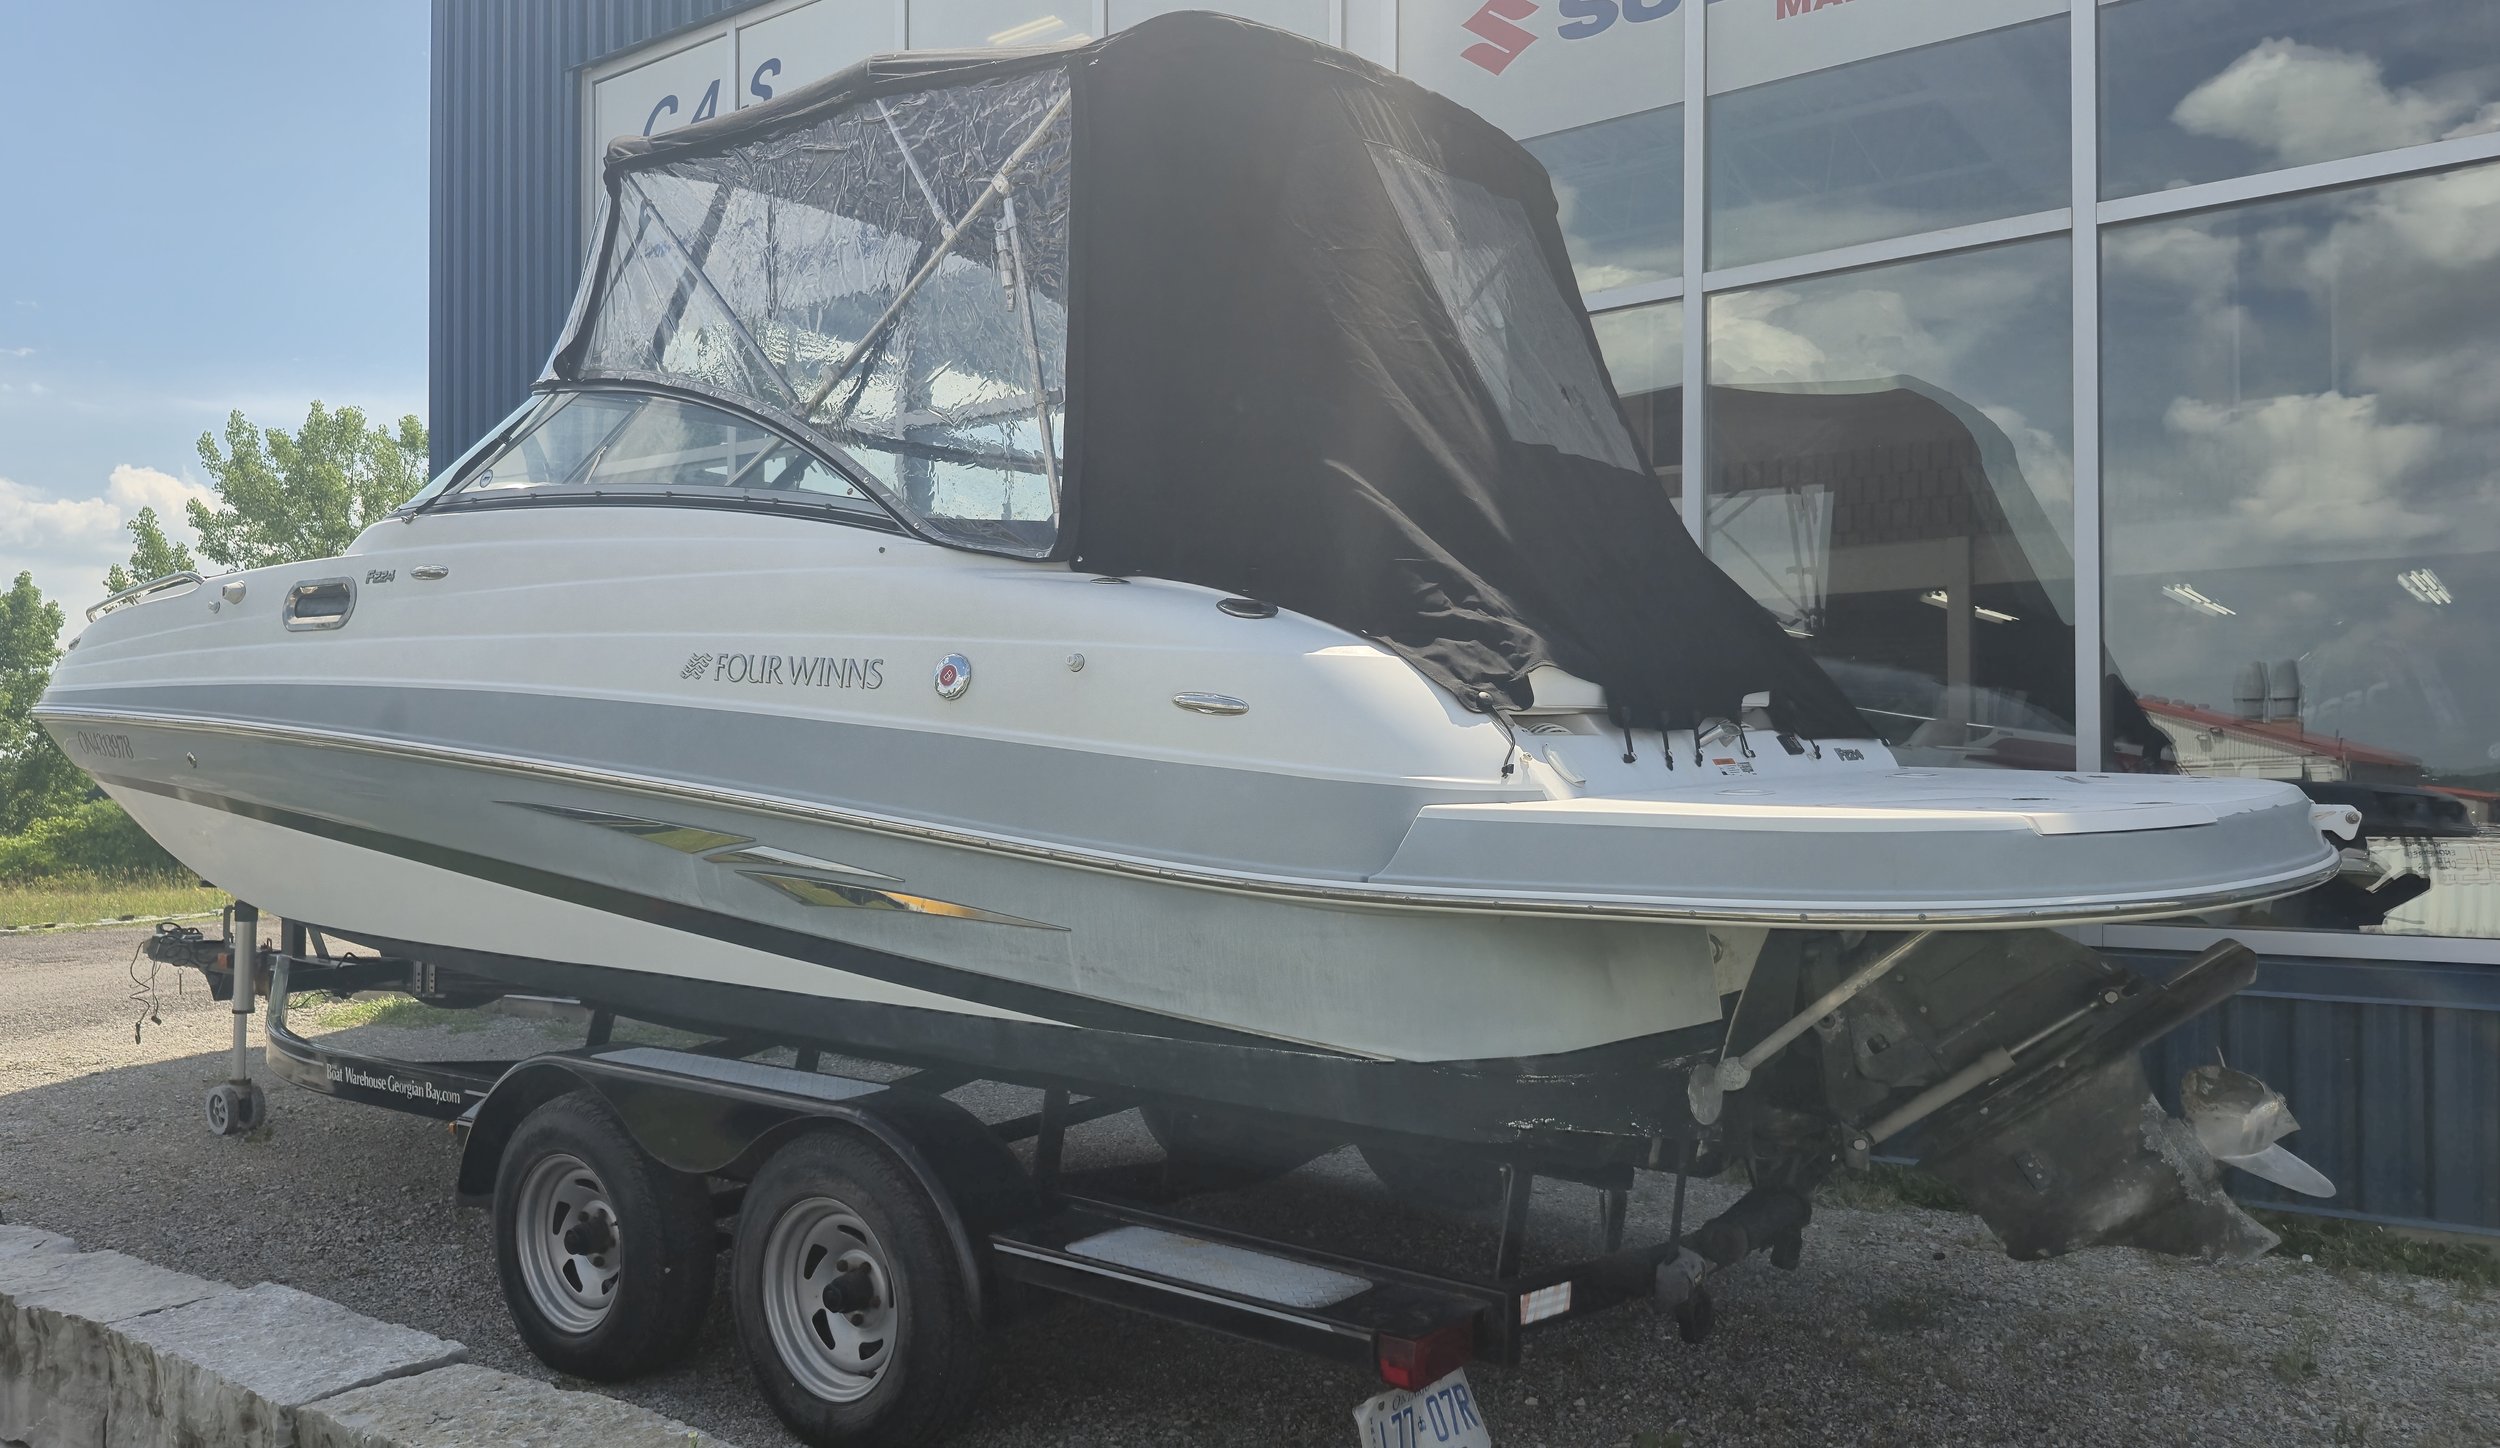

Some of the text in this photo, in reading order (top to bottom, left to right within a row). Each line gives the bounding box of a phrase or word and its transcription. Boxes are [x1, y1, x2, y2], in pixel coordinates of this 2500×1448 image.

[365, 569, 396, 584] F224
[713, 653, 884, 690] FOUR WINNS
[326, 1063, 461, 1105] Boat Warehouse Georgian Bay.com
